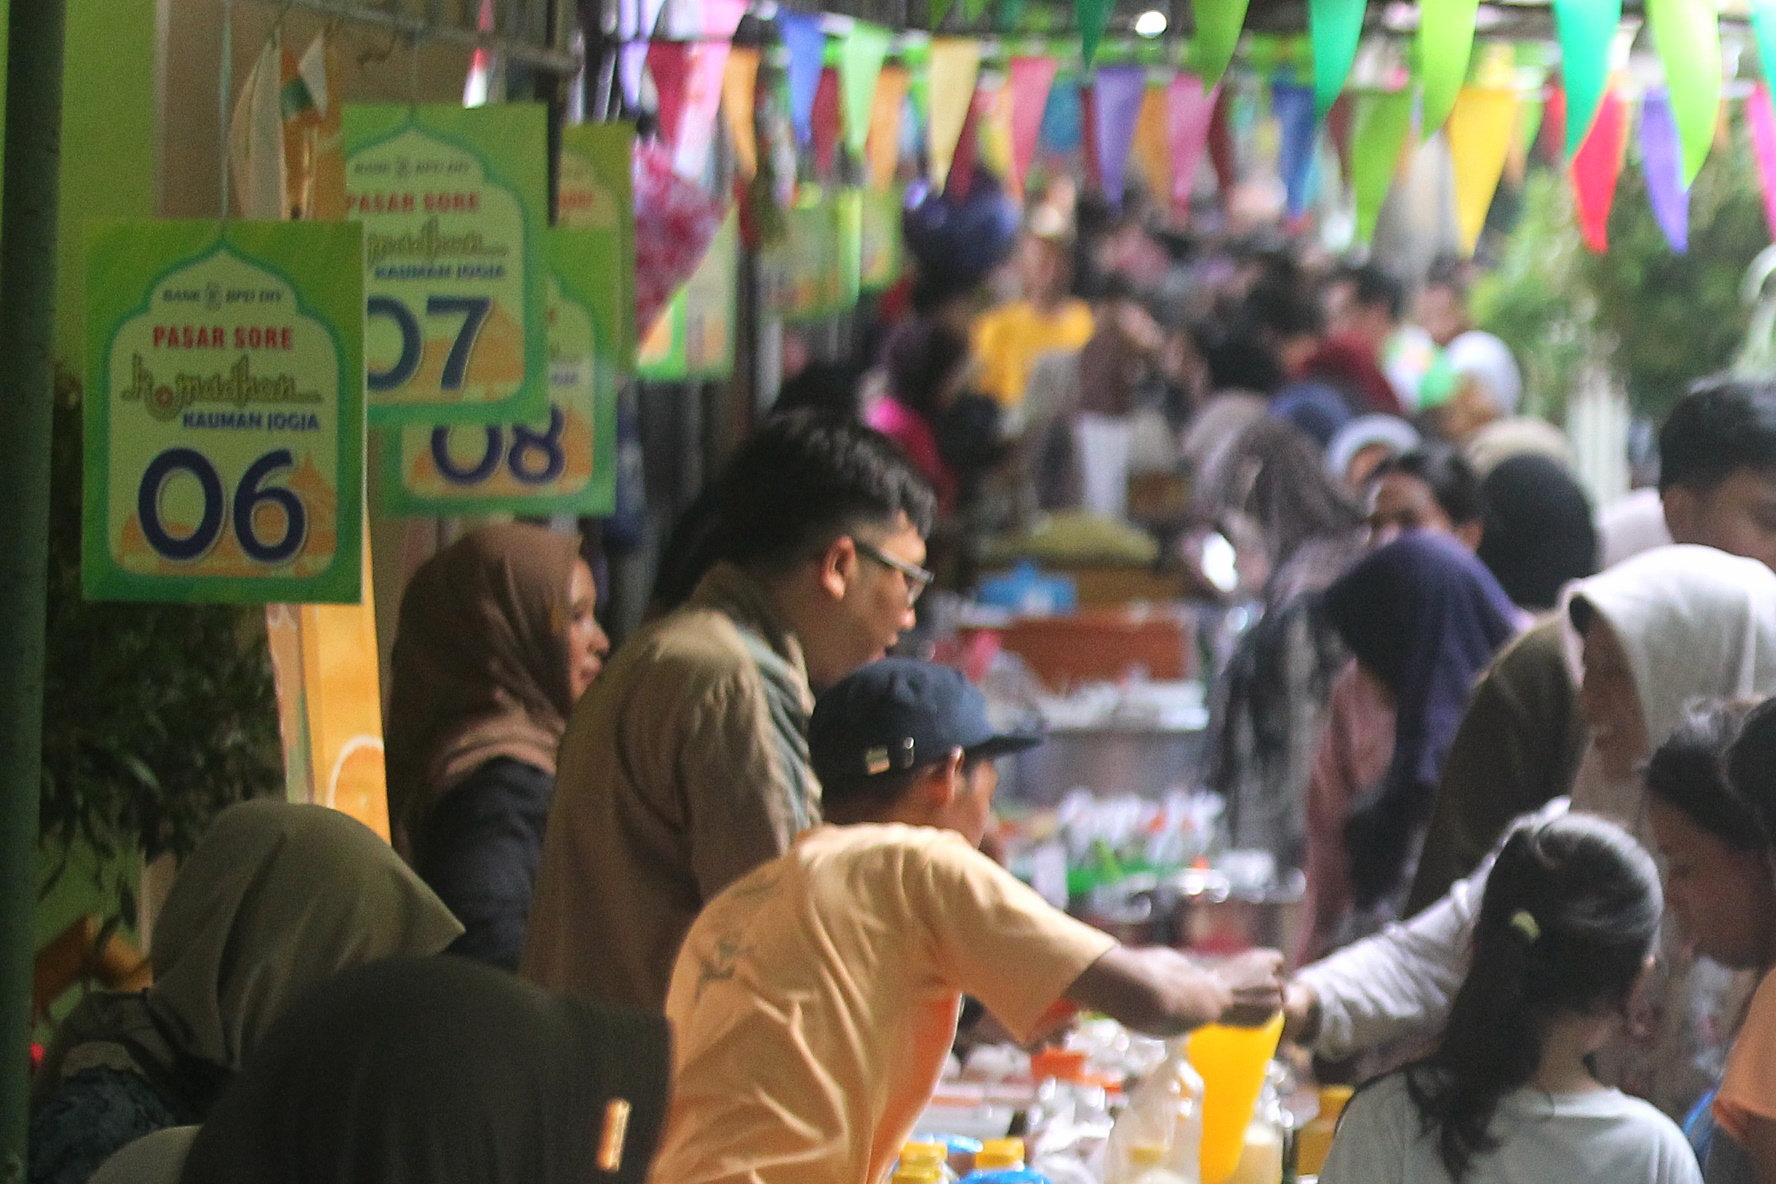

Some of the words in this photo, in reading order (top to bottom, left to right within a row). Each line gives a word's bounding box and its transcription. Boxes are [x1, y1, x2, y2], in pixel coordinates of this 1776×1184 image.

[424, 192, 481, 213] SORE
[153, 325, 225, 348] PASAR
[234, 326, 293, 348] SORE
[368, 295, 492, 393] 07
[183, 412, 263, 430] KAUMAN
[268, 412, 321, 431] JOGJA
[431, 402, 565, 486] 08
[138, 447, 308, 563] 06
